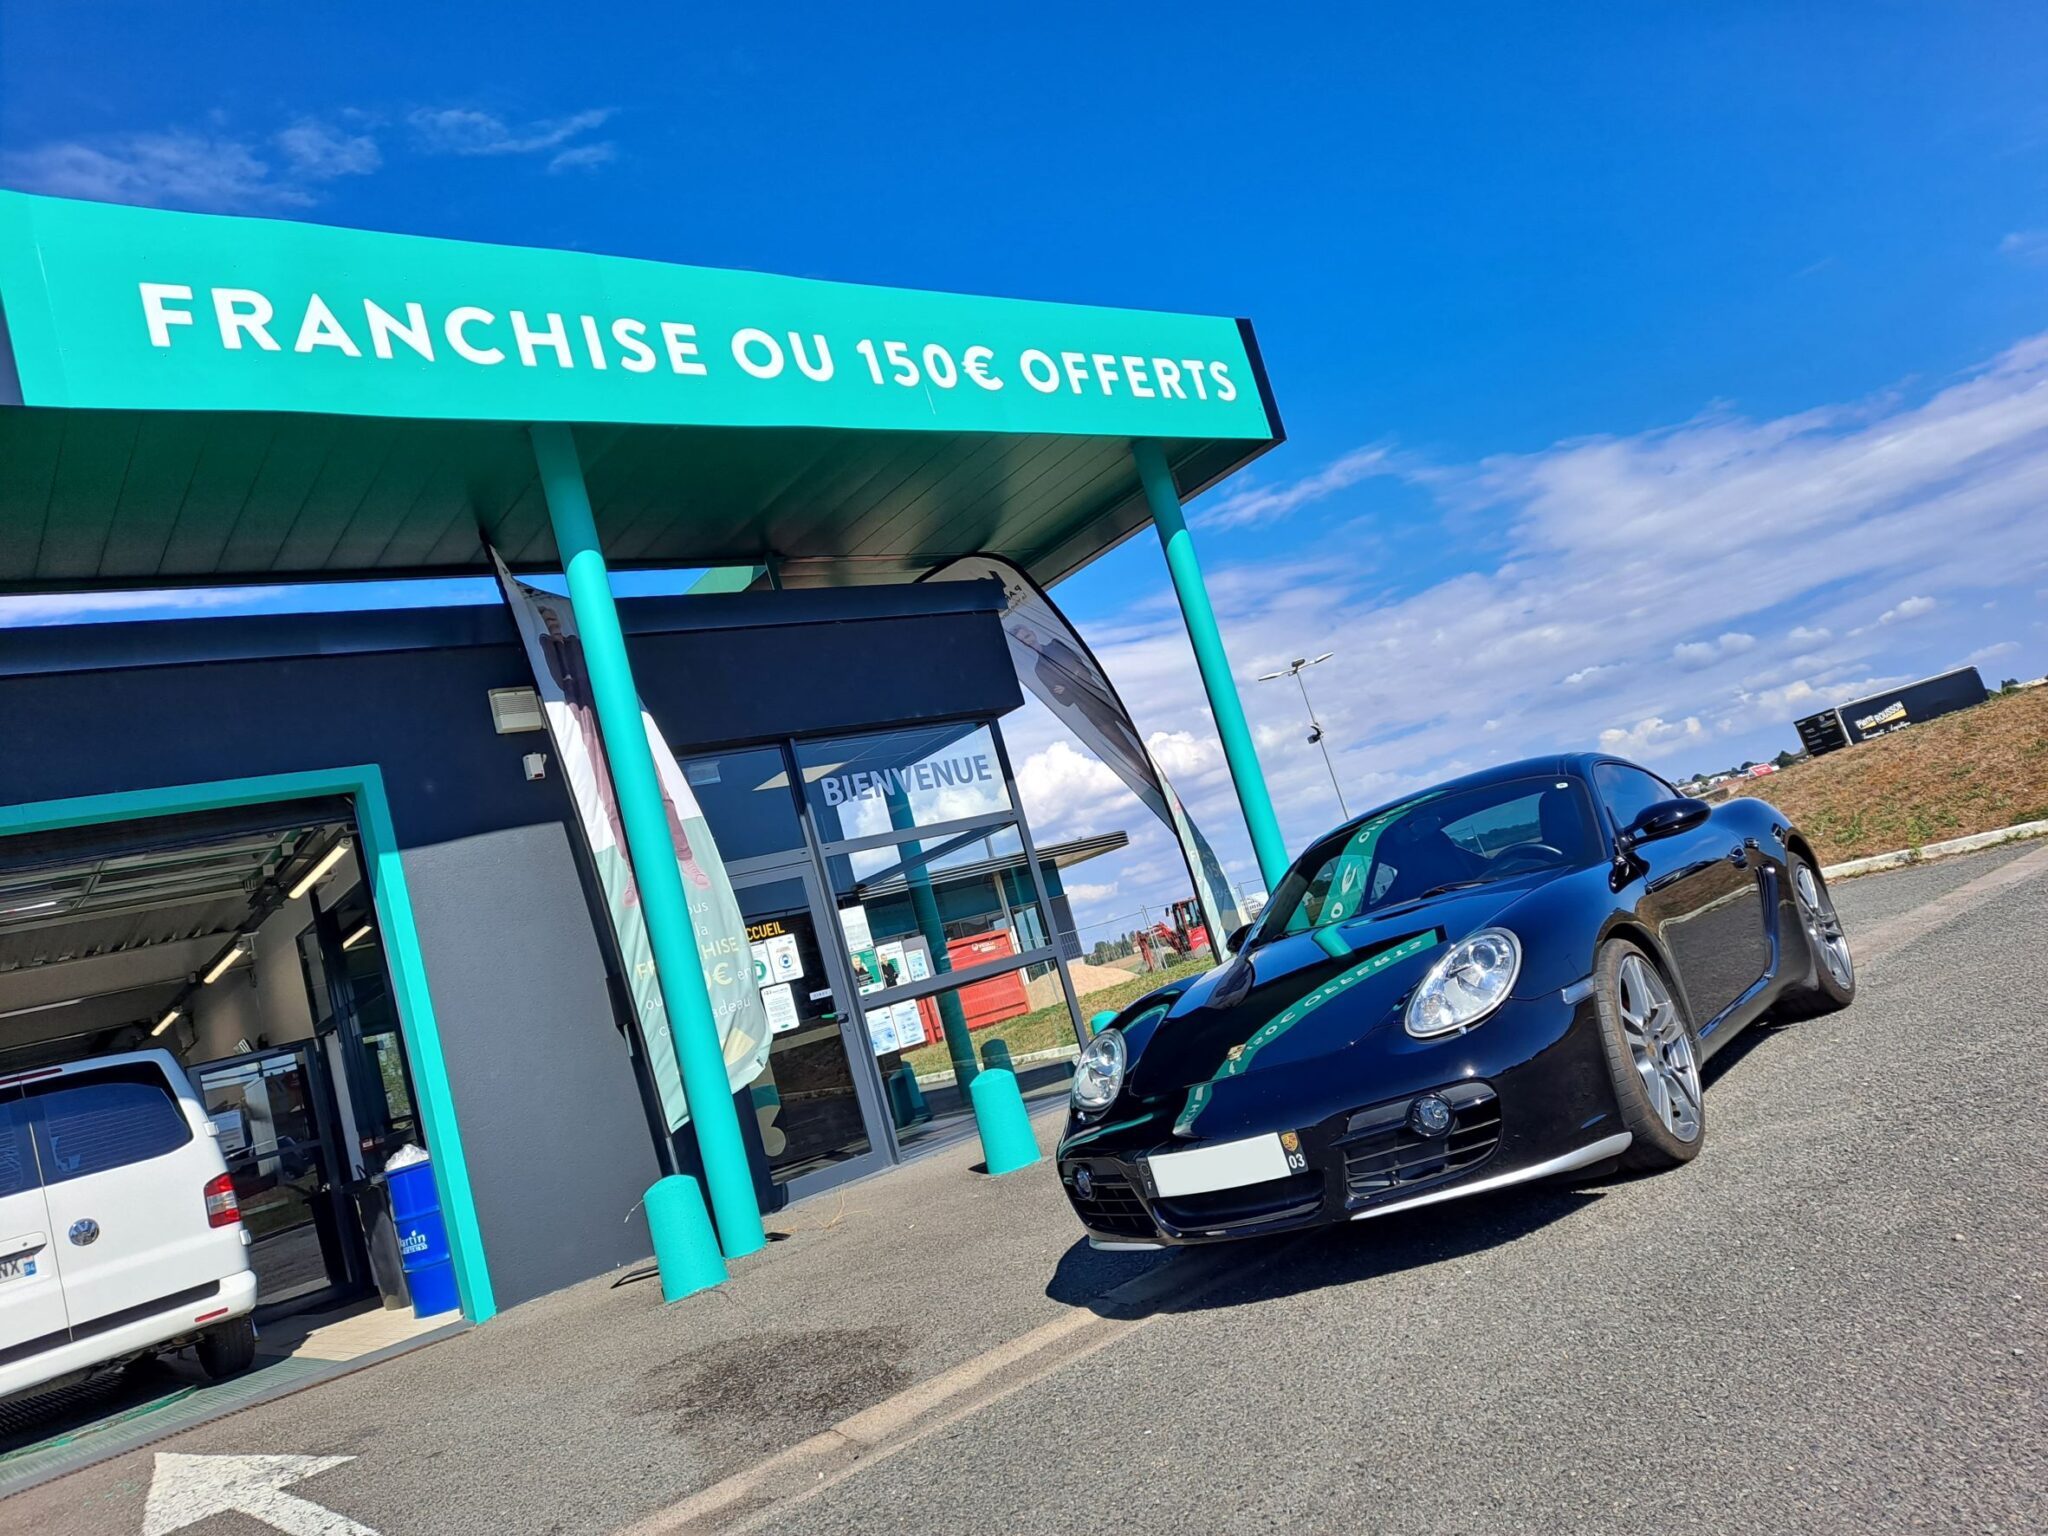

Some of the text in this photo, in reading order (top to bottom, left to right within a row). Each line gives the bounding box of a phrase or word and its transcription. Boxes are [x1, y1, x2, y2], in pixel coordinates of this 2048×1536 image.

[139, 283, 1237, 402] FRANCHISE OU 150€ OFFERTS
[821, 755, 992, 806] BIENVENUE
[745, 921, 785, 941] CCUEIL
[1288, 1153, 1306, 1169] 03
